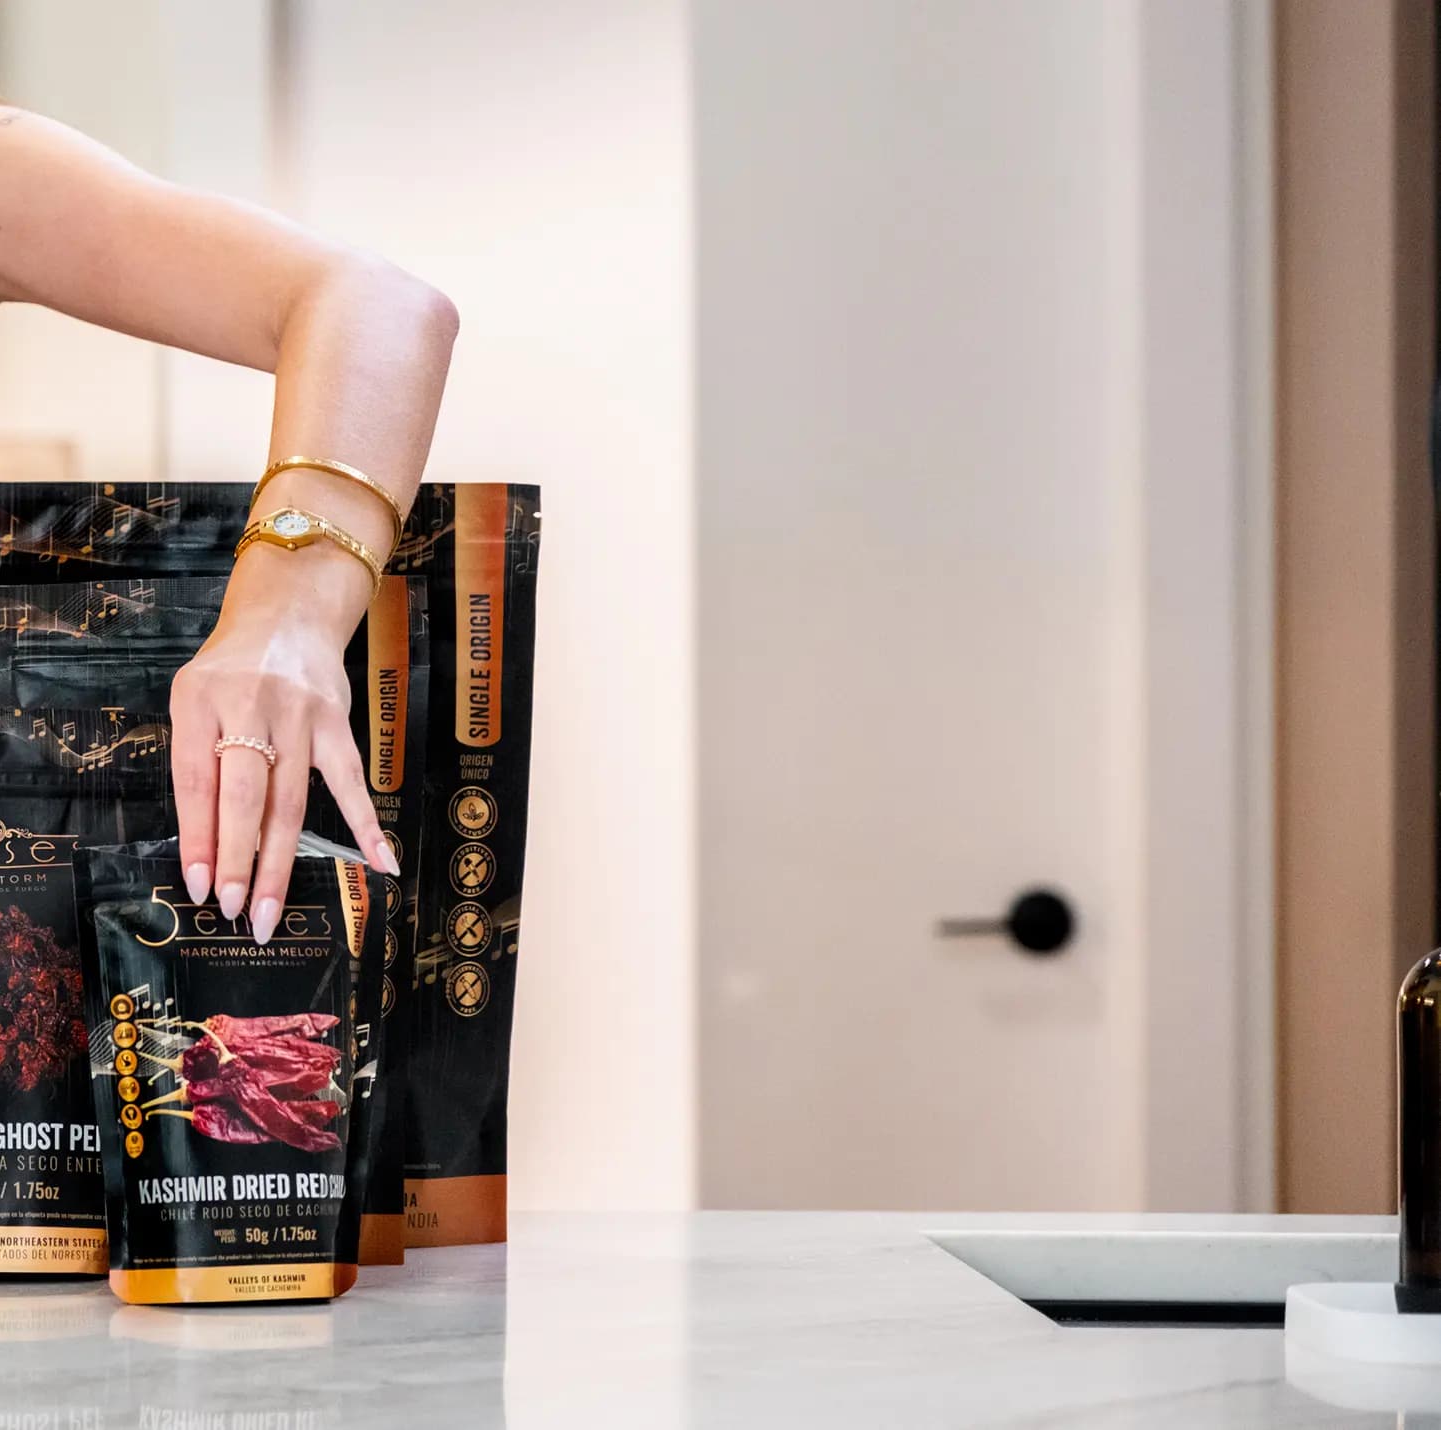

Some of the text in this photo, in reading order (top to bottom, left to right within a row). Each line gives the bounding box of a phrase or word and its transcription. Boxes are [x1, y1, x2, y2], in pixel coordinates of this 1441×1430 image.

[469, 594, 492, 739] SINGLE ORIGIN
[379, 669, 398, 786] SINGLE ORIGIN
[459, 754, 494, 767] ORIGEN
[352, 905, 364, 953] SINGLE
[180, 946, 330, 957] MARCHWAGAN MELODY
[17, 1155, 58, 1171] SECO
[0, 1181, 7, 1199] /
[13, 1182, 60, 1200] 1.75oz
[138, 1175, 227, 1205] KASHMIR
[232, 1173, 291, 1200] DRIED
[295, 1173, 329, 1199] RED
[160, 1207, 196, 1221] CHILE
[202, 1206, 233, 1220] ROJO
[239, 1204, 271, 1218] SECO
[276, 1204, 291, 1217] DE
[0, 1237, 69, 1247] NORTHEASTERN
[245, 1226, 318, 1245] 50g / 1.75oz
[31, 1250, 48, 1260] DEL
[228, 1274, 306, 1285] VALLEYS OF KASHMIR
